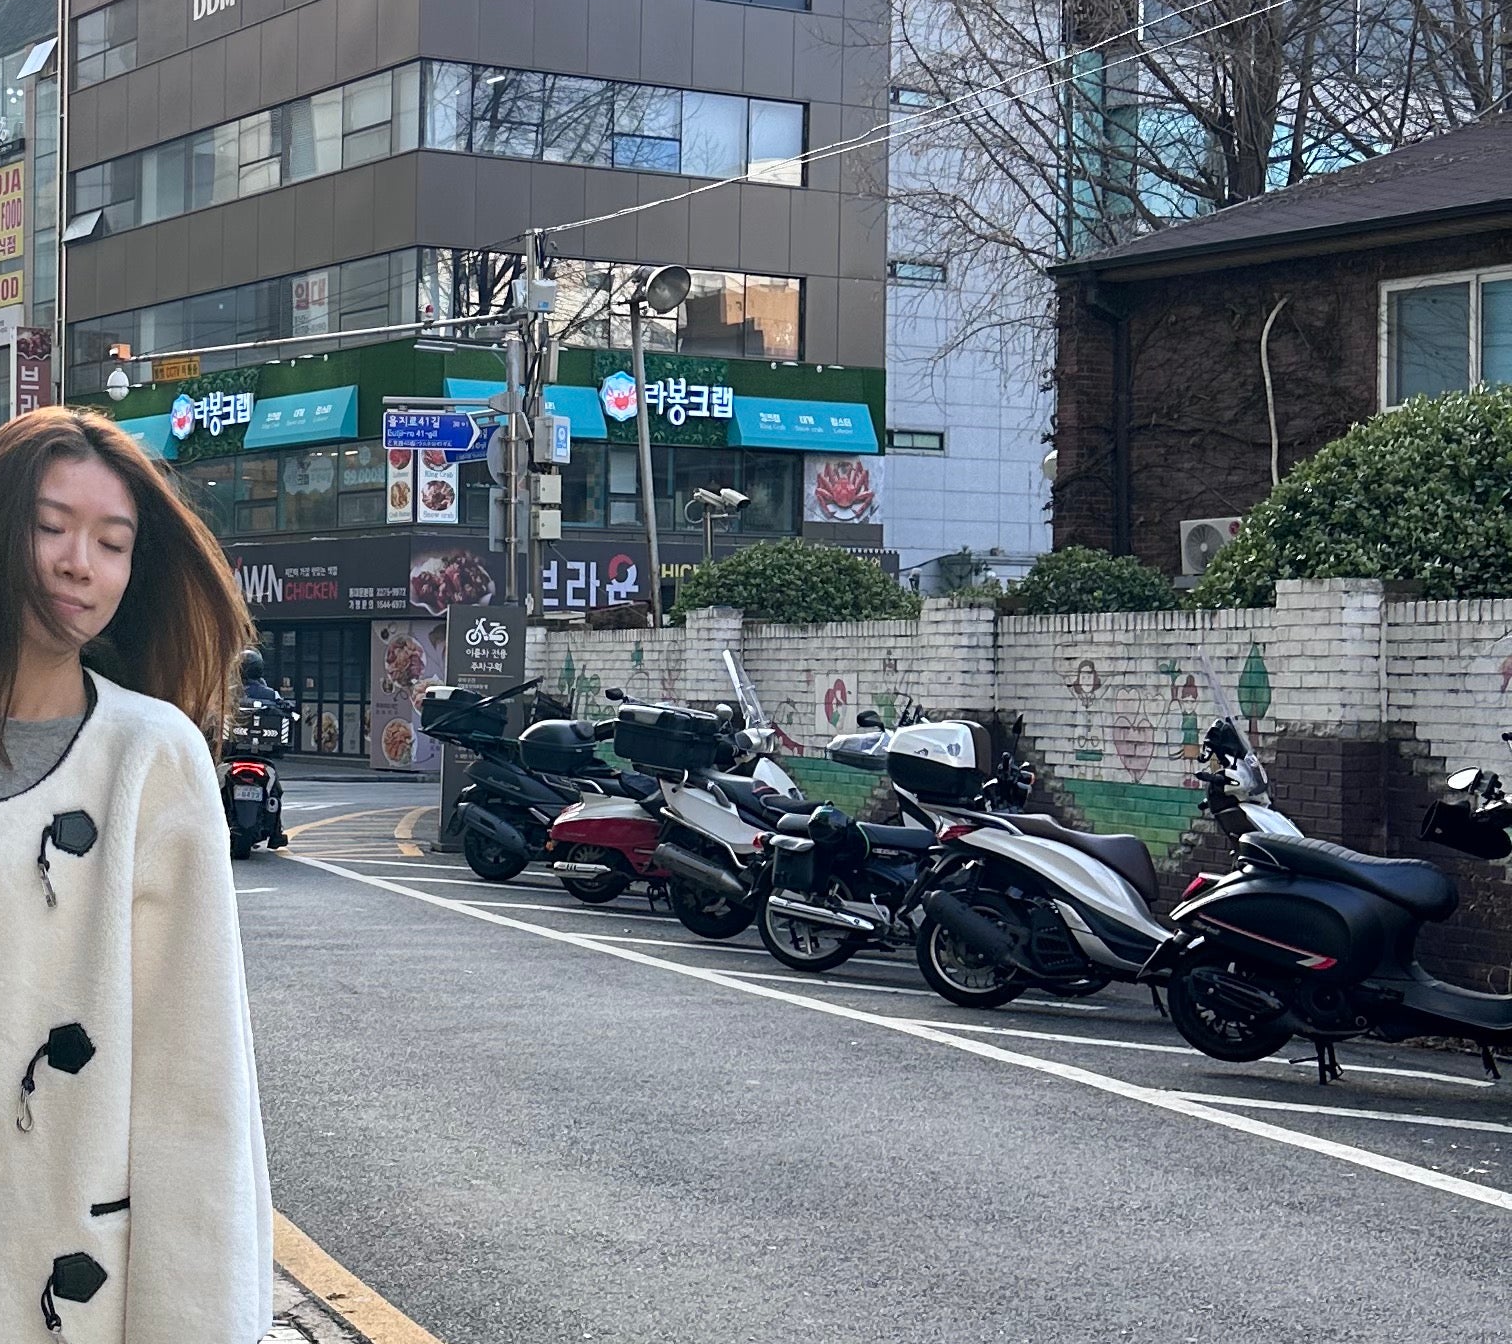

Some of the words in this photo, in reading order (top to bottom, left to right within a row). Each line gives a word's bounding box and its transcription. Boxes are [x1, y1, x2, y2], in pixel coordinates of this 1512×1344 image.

[1, 197, 21, 232] FOOD
[645, 377, 734, 426] 라봉크랩
[194, 391, 254, 436] 라봉크랩
[388, 416, 440, 428] 을지로41길
[466, 648, 490, 659] 이륜차
[491, 648, 508, 660] 전용
[470, 661, 503, 673] 주차구역
